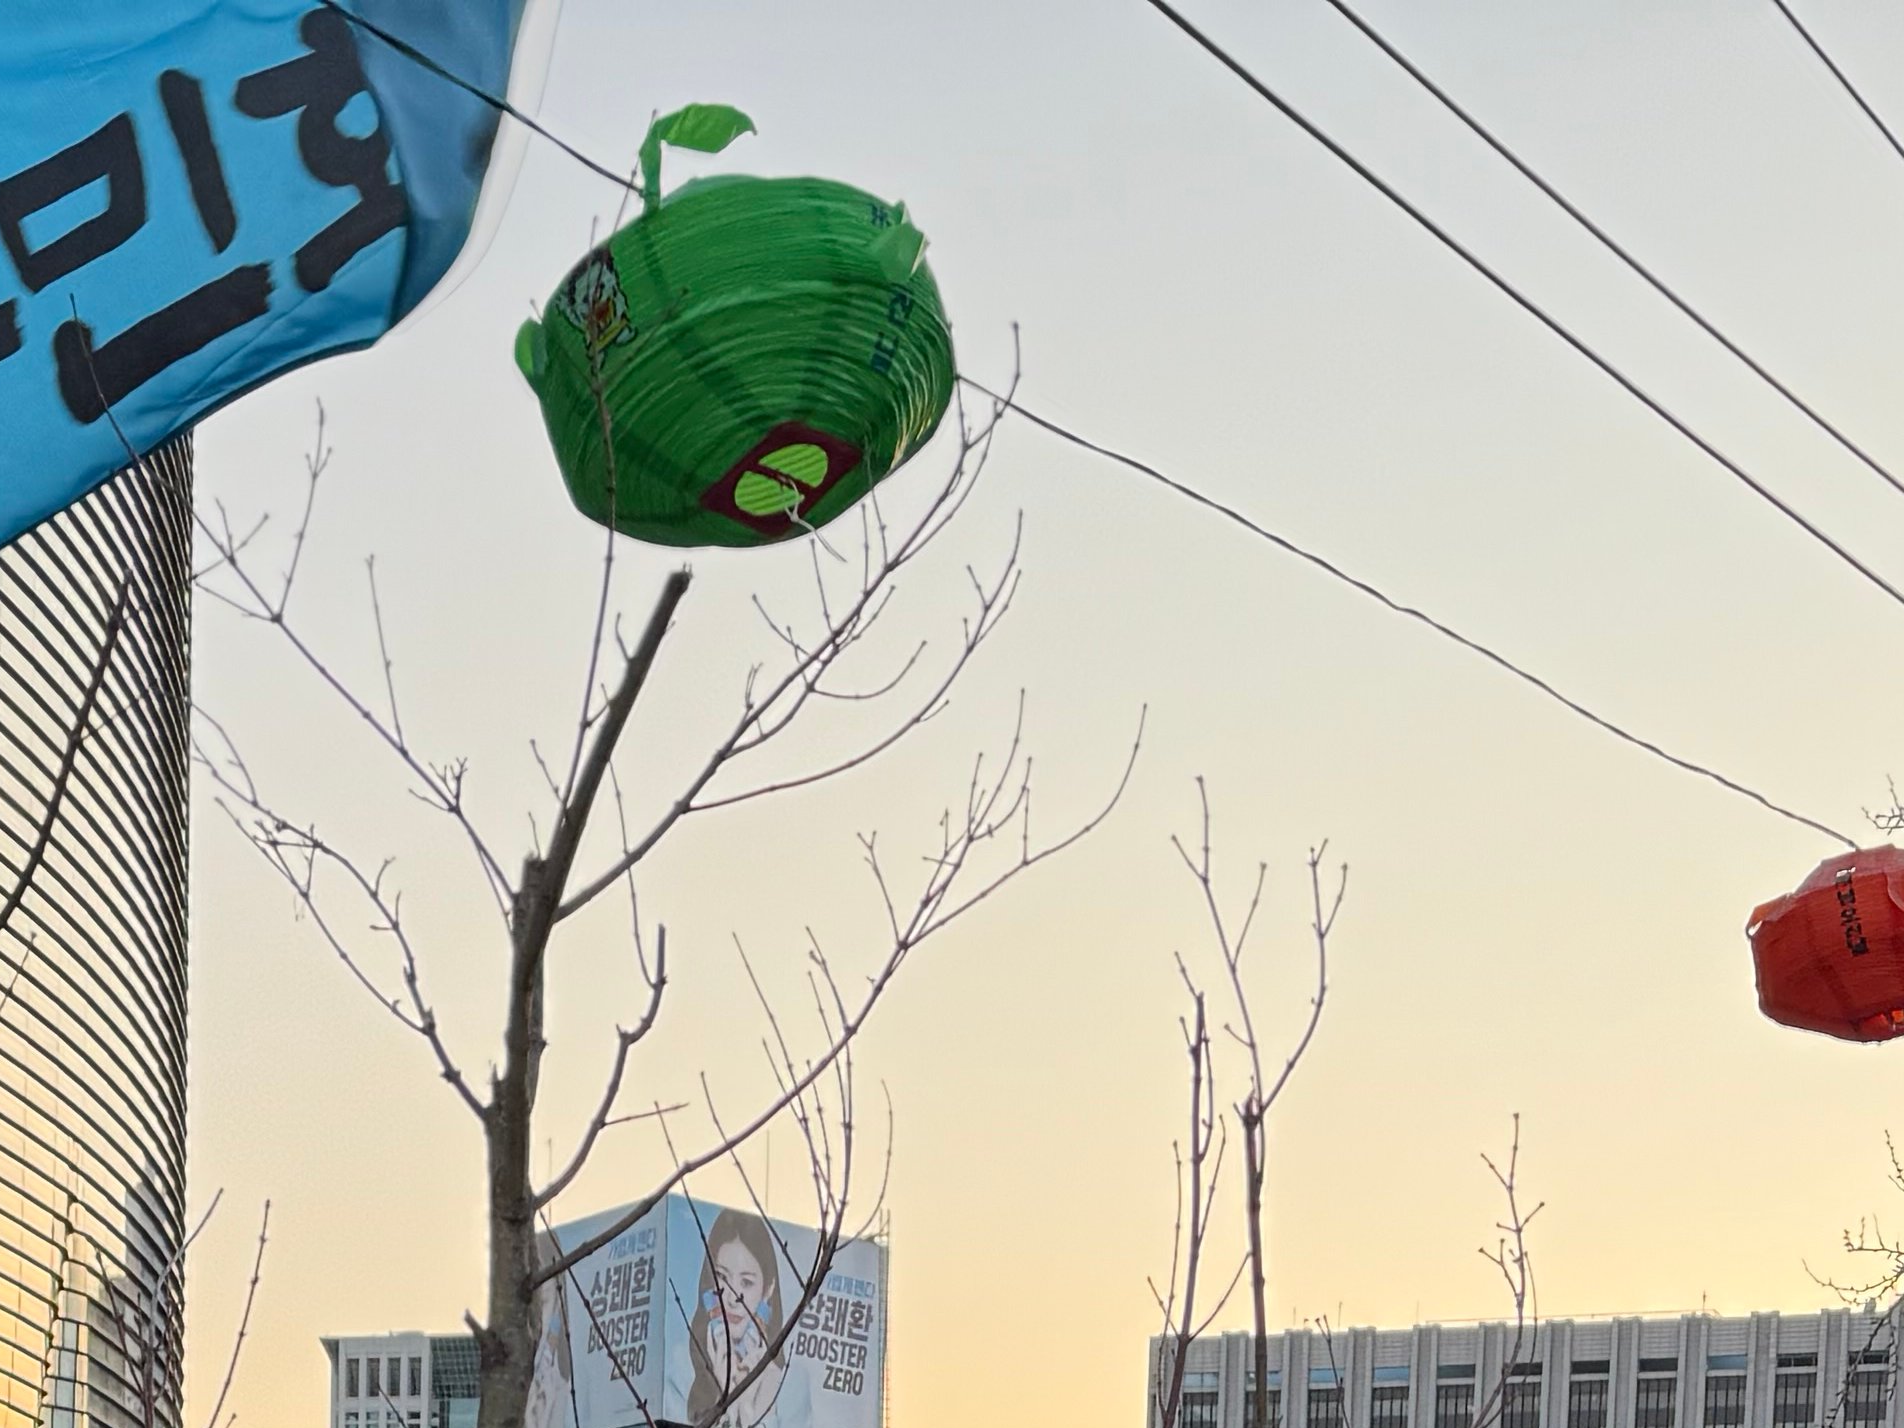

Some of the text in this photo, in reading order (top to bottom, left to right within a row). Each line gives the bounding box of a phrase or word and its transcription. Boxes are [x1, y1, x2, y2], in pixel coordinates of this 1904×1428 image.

[590, 1254, 656, 1319] 상쾌환
[588, 1309, 650, 1355] BOOSTER
[610, 1347, 647, 1382] ZERO
[796, 1335, 868, 1369] BOOSTER
[822, 1365, 864, 1397] ZERO
